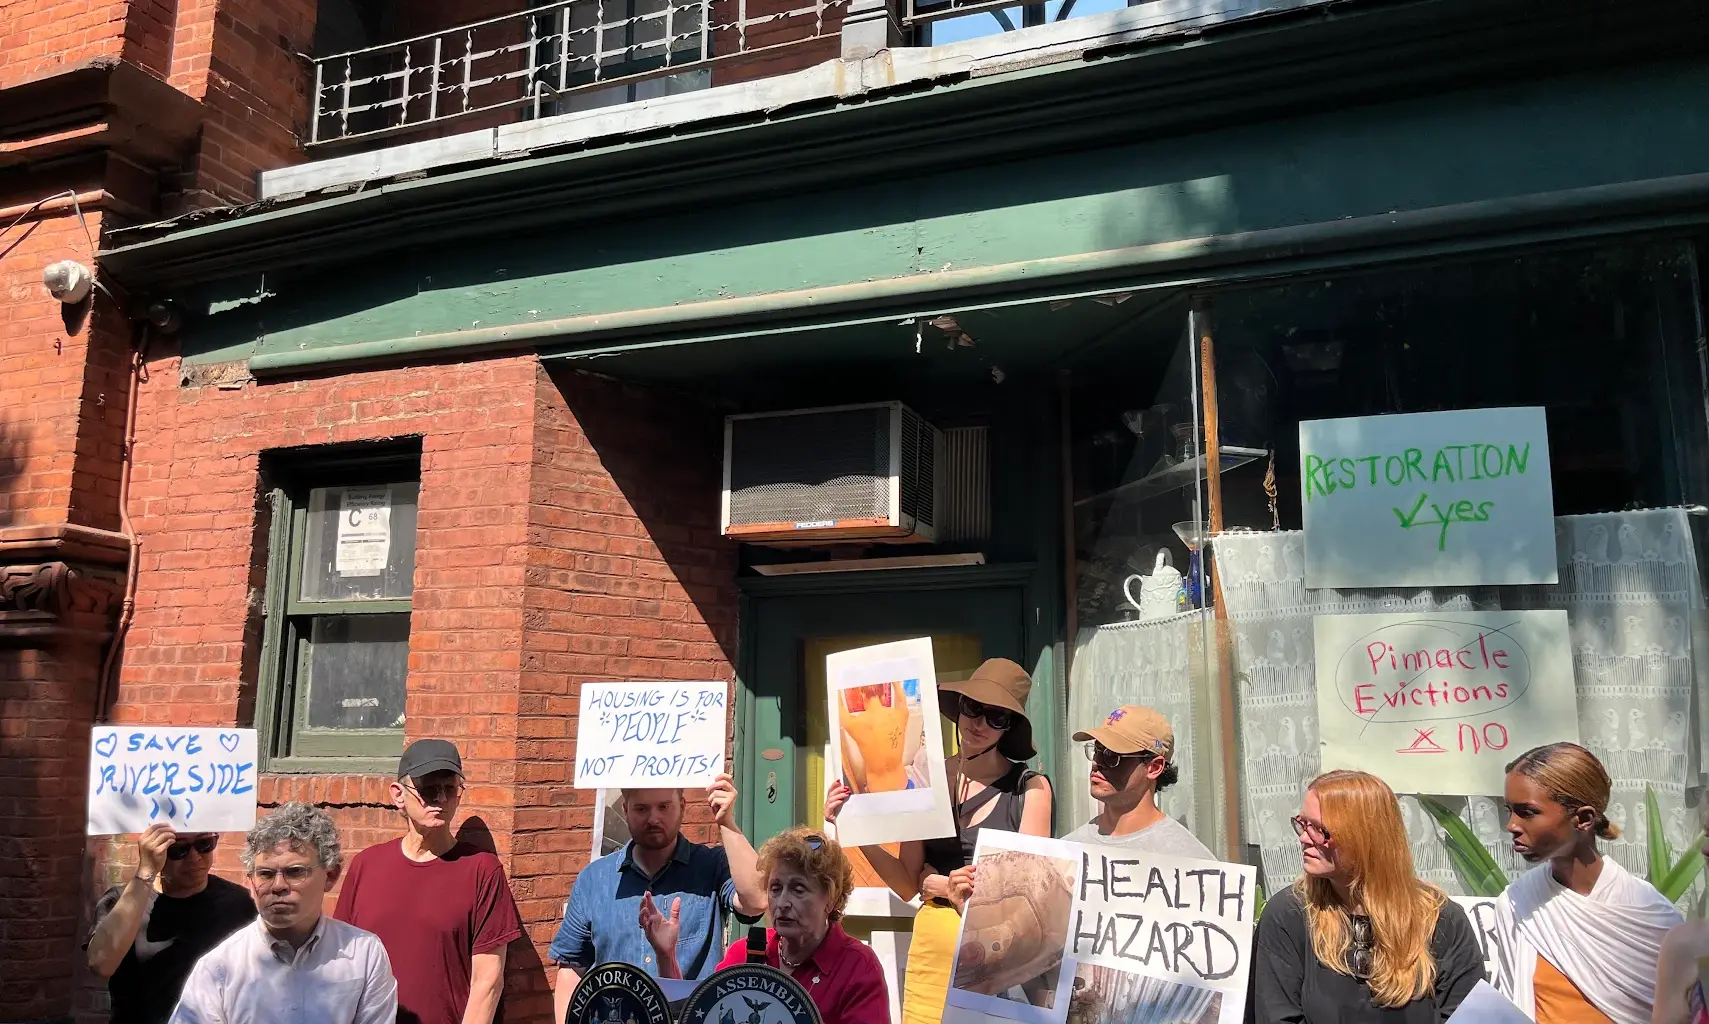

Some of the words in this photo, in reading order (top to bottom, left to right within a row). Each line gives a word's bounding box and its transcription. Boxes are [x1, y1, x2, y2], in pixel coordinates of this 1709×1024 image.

[1305, 442, 1531, 503] RESTORATION
[348, 508, 363, 527] C
[368, 512, 378, 521] 68
[1431, 500, 1495, 552] yes
[588, 689, 665, 711] HOUSING
[669, 689, 690, 708] IS
[694, 690, 724, 708] FOR
[1353, 681, 1509, 715] Evictions
[127, 732, 203, 755] SAVE
[96, 760, 254, 796] RIVERSIDE
[579, 754, 625, 779] NOT
[630, 753, 721, 778] PROFITS!
[1080, 851, 1246, 922] HEALTH
[1072, 909, 1240, 981] HAZARD
[572, 980, 594, 1018] NEW
[595, 970, 633, 988] YORK
[632, 979, 664, 1024] STATE
[715, 976, 807, 1017] ASSEMBLY
